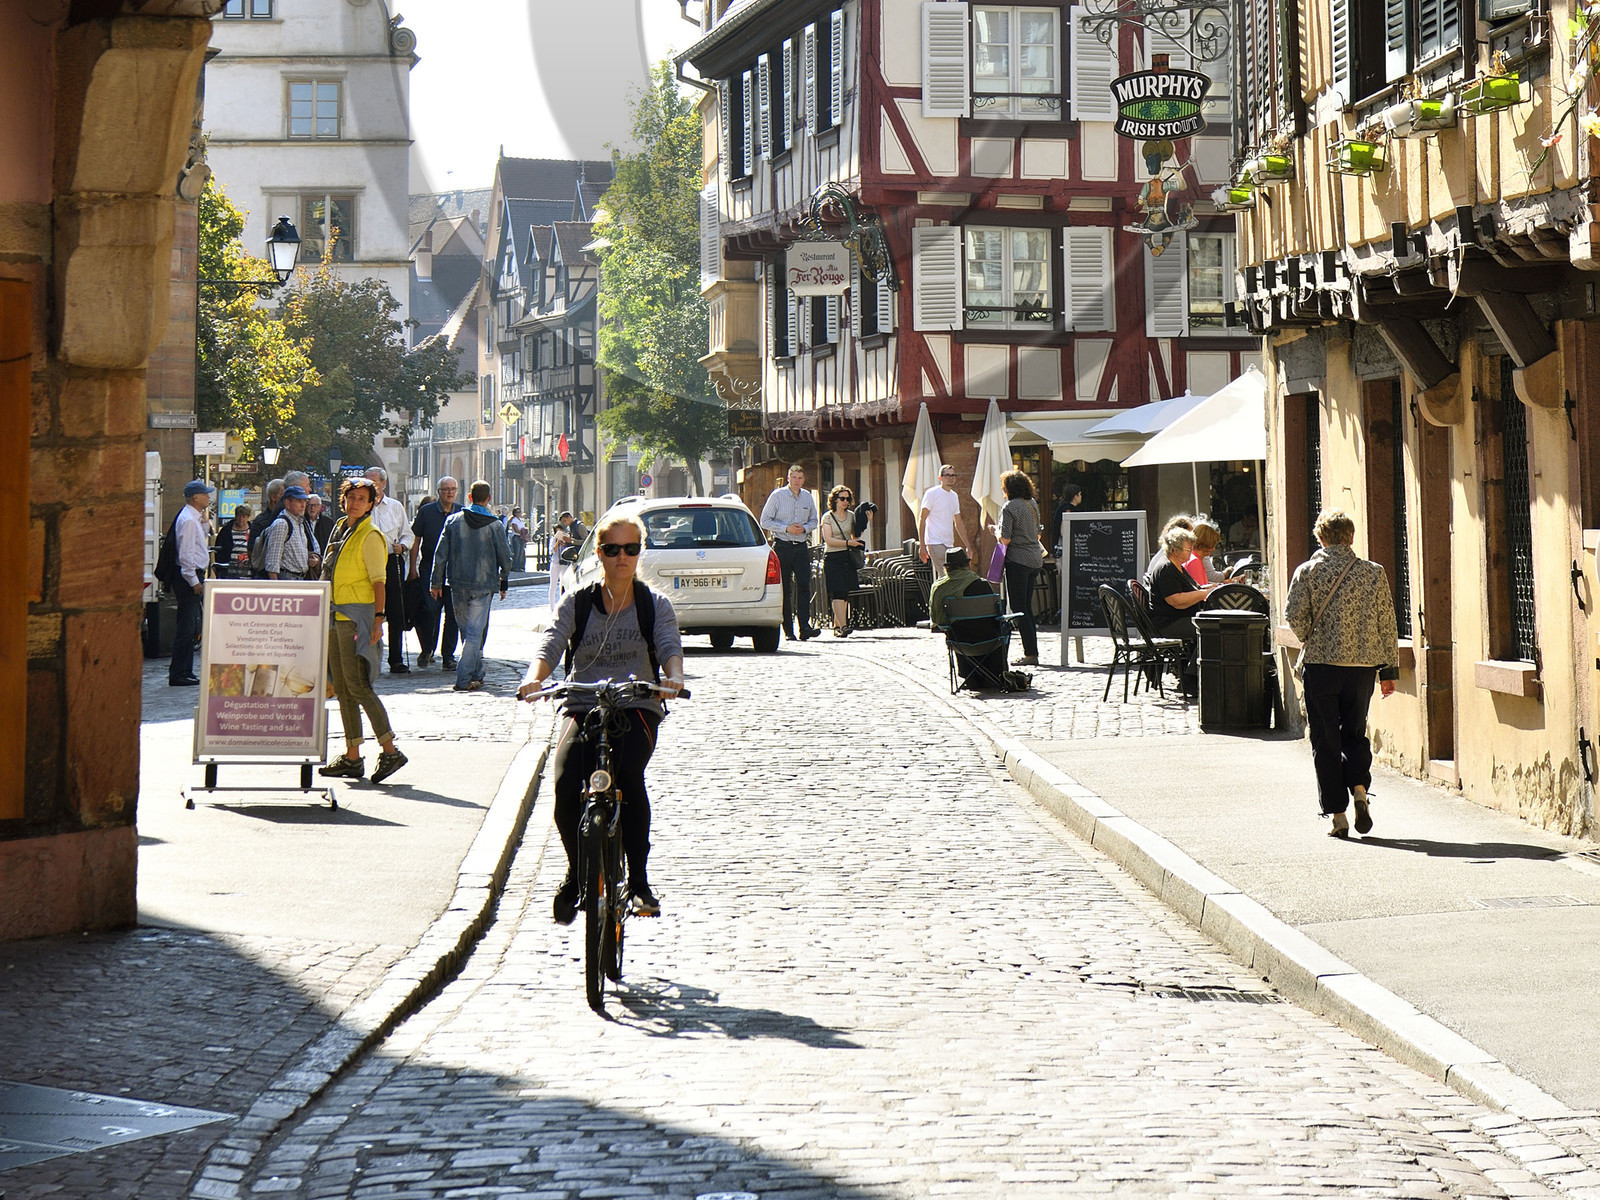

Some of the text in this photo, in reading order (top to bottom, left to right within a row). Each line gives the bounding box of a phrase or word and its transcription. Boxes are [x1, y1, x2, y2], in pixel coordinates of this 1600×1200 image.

[1116, 75, 1203, 103] MURPHY'S
[1120, 117, 1198, 136] IRISH STOUT
[800, 252, 836, 261] Restaurant
[789, 266, 846, 287] Fer Rouge
[231, 596, 304, 613] OUVERT
[236, 636, 268, 644] Vendanges
[274, 651, 297, 659] liqueurs
[224, 700, 269, 710] Dégustation
[216, 712, 258, 720] Weinprobe
[259, 712, 274, 720] und
[241, 723, 268, 732] Tasting
[208, 738, 310, 747] www.domaineviticolecolmar.fr
